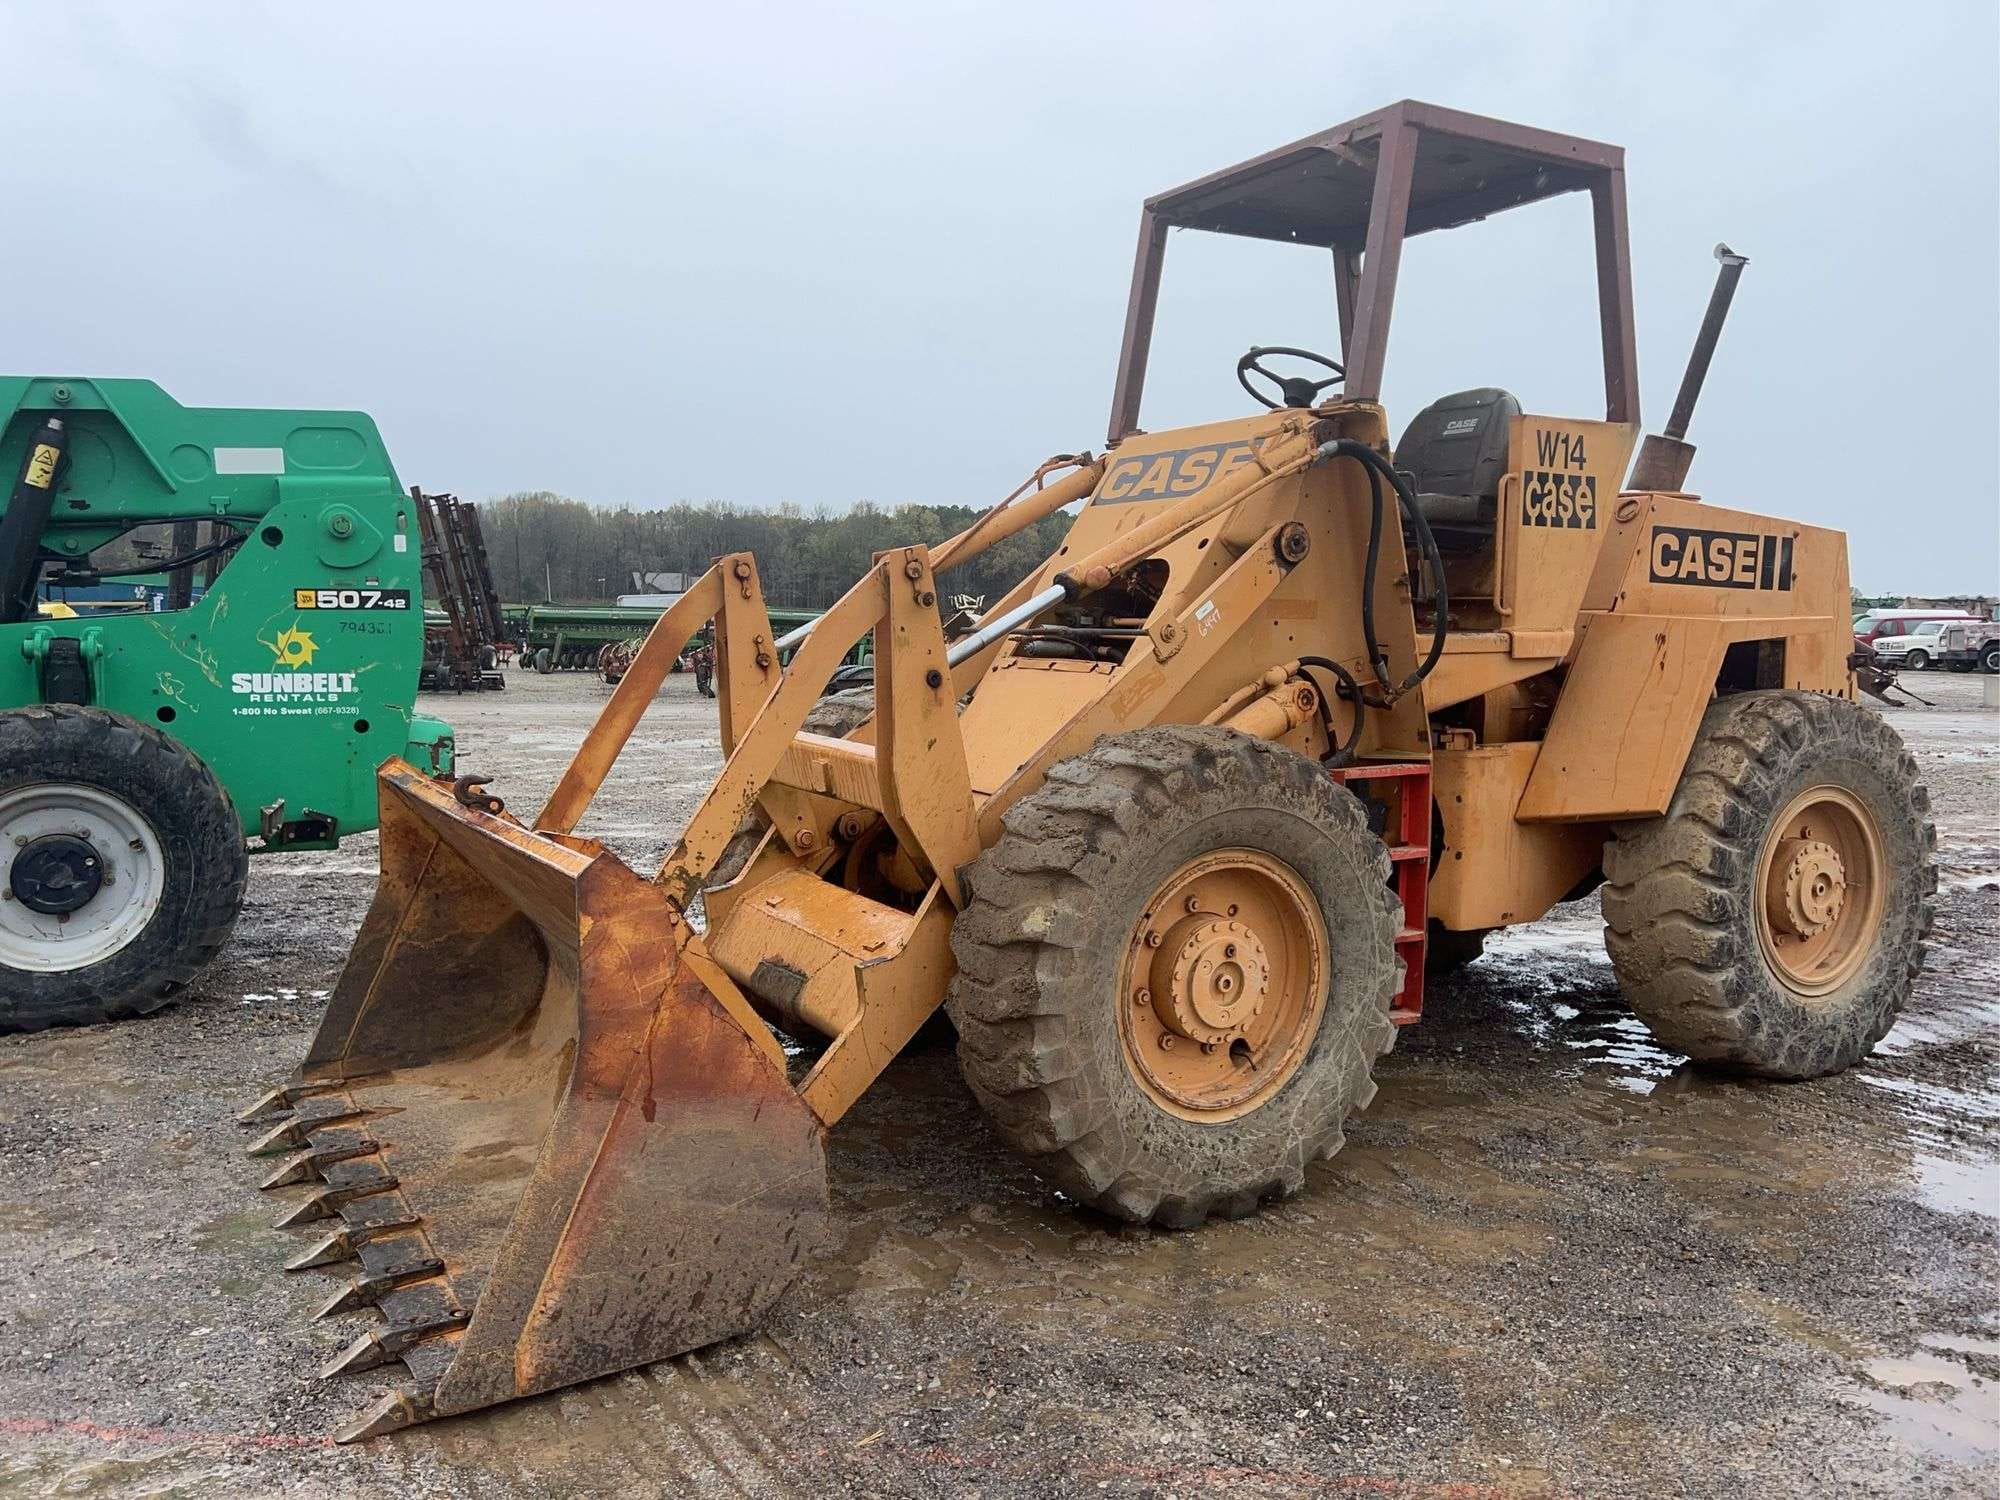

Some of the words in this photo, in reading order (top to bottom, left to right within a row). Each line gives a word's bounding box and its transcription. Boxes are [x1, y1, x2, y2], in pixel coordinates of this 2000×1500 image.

[1447, 418, 1479, 429] CASE
[1536, 429, 1587, 471] W14
[1525, 479, 1594, 522] case
[317, 590, 406, 609] 507-42
[231, 673, 356, 694] SUNBELT
[250, 694, 339, 702] RENTALS
[280, 707, 312, 715] Sweat
